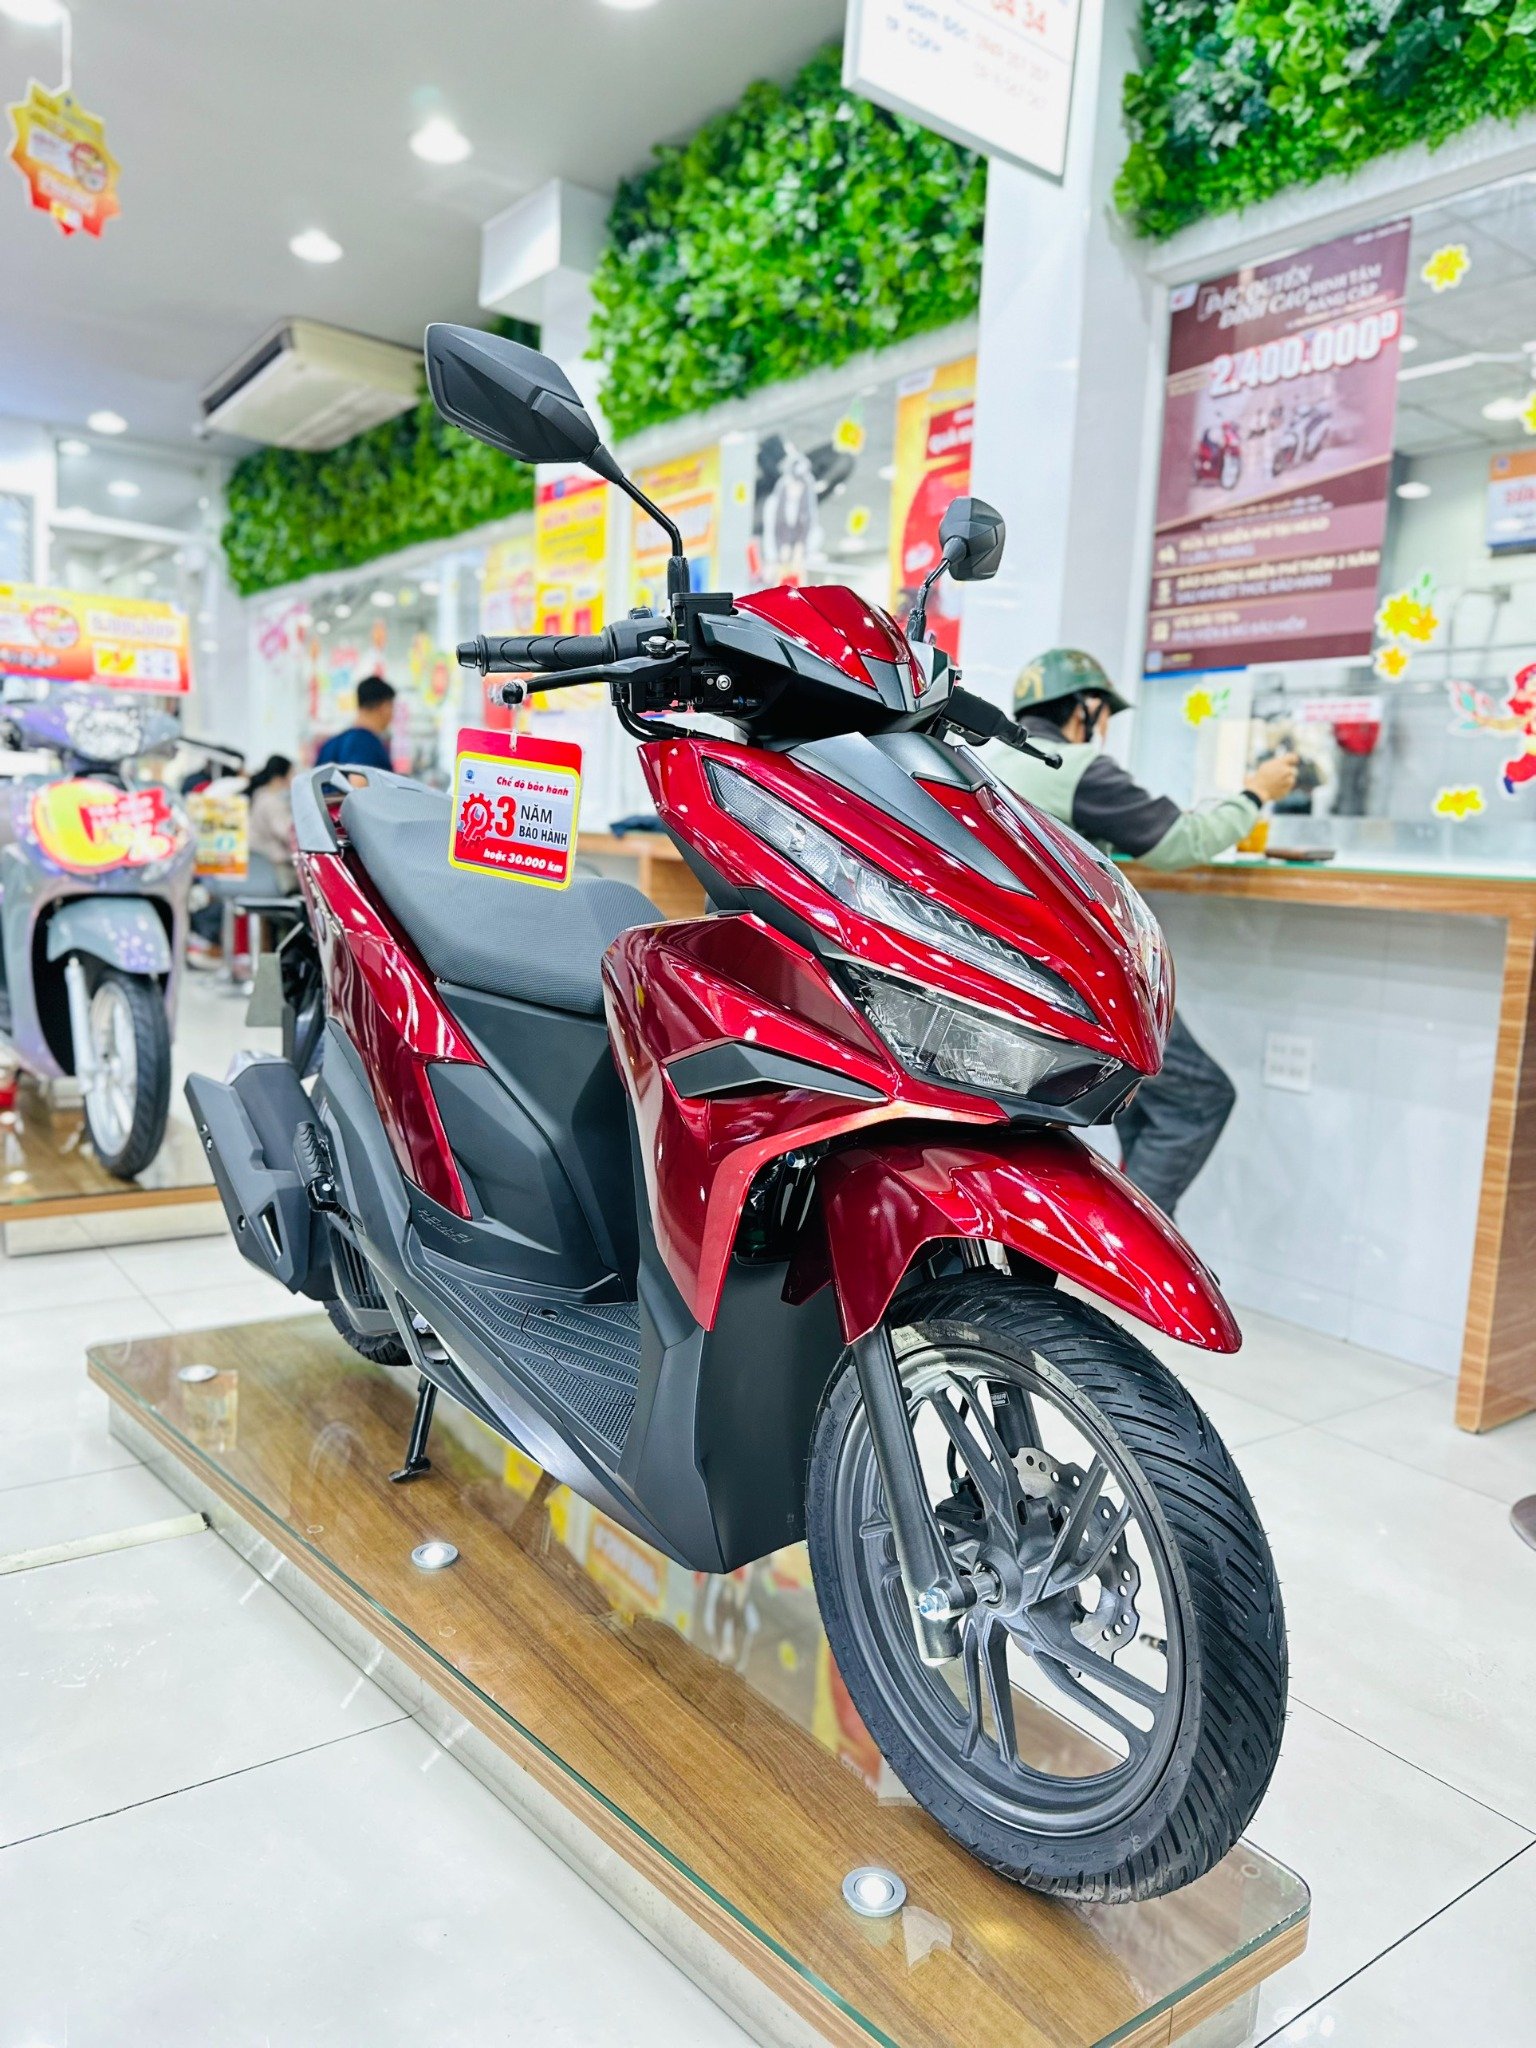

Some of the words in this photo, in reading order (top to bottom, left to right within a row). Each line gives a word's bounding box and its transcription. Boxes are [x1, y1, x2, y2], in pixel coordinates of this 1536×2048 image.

[497, 776, 513, 787] Chế
[514, 780, 525, 791] độ
[527, 781, 544, 792] bảo
[546, 785, 569, 797] hành
[495, 795, 517, 838] 3
[520, 804, 552, 825] NĂM
[519, 822, 538, 840] BẢO
[540, 828, 568, 846] HÀNH
[483, 848, 507, 863] hoặc
[507, 852, 546, 870] 30.000
[547, 857, 563, 874] km
